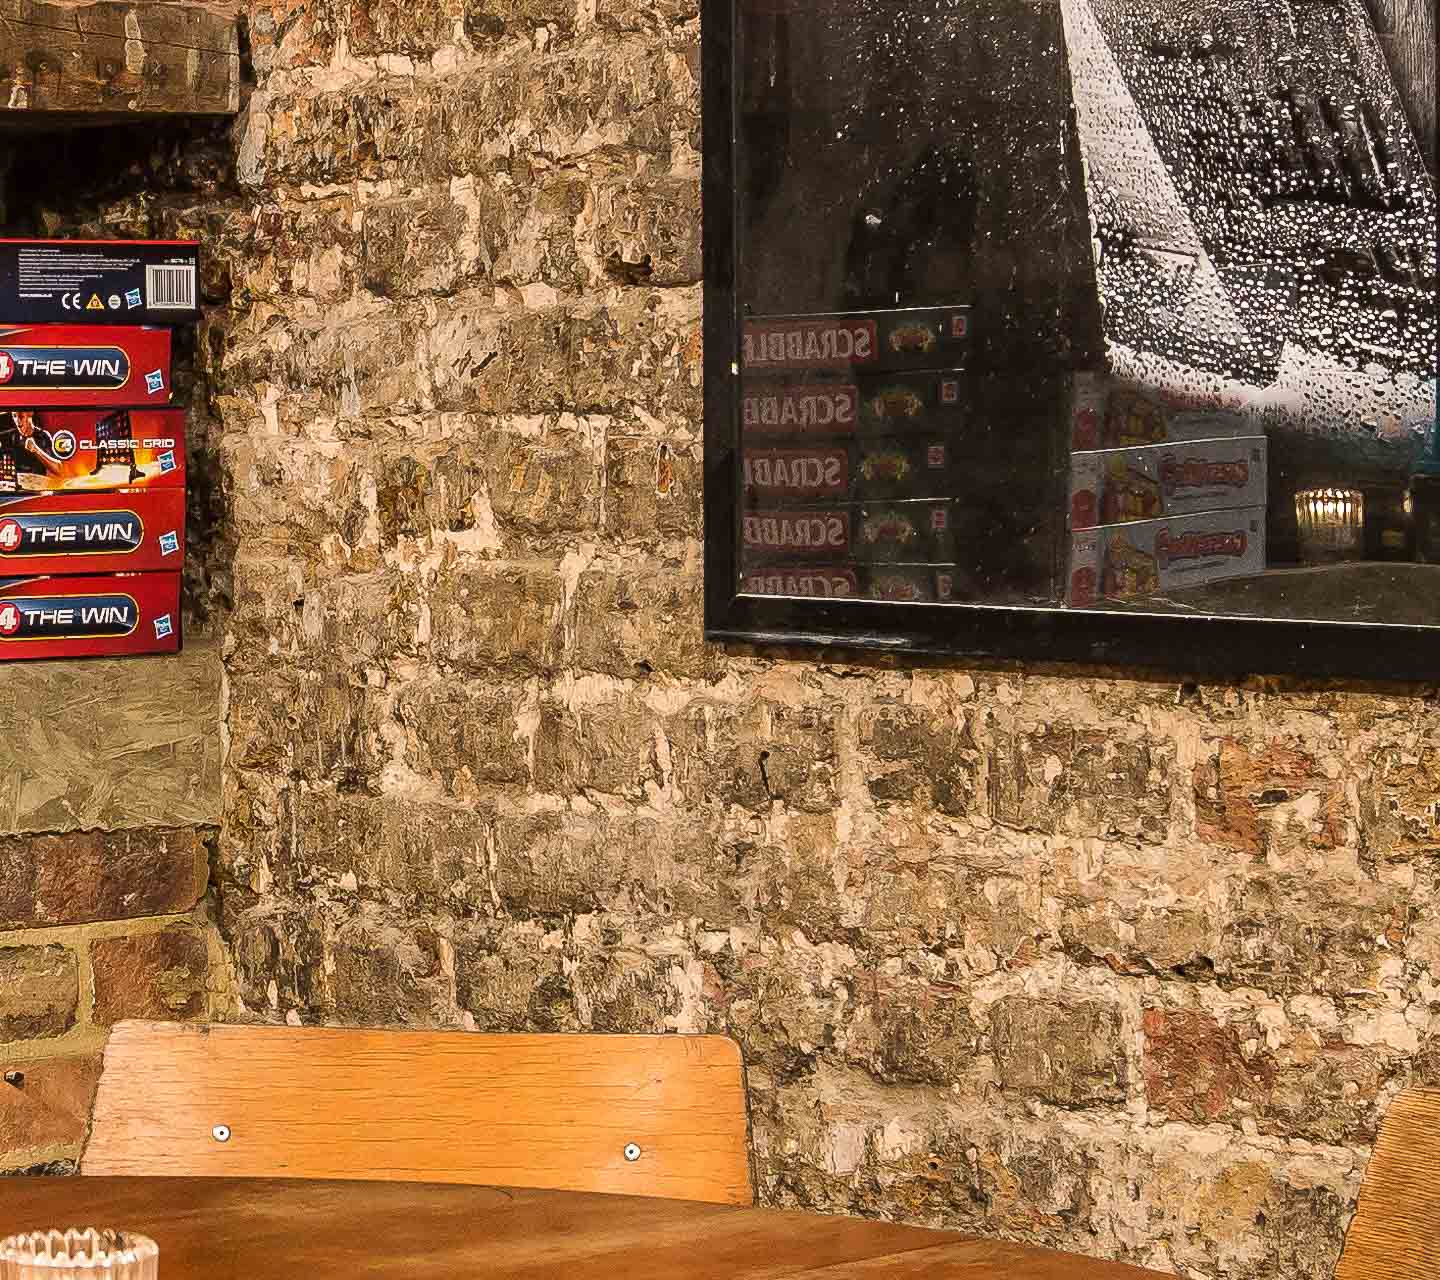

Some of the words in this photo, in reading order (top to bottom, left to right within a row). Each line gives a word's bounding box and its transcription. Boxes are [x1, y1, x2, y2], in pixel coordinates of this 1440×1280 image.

[17, 360, 68, 376] THE
[70, 359, 120, 375] WIN
[80, 439, 141, 450] CLASSIC
[143, 438, 175, 449] GRID
[25, 526, 77, 543] THE
[83, 523, 133, 541] WIN
[24, 609, 75, 625] THE
[80, 606, 129, 623] WIN
